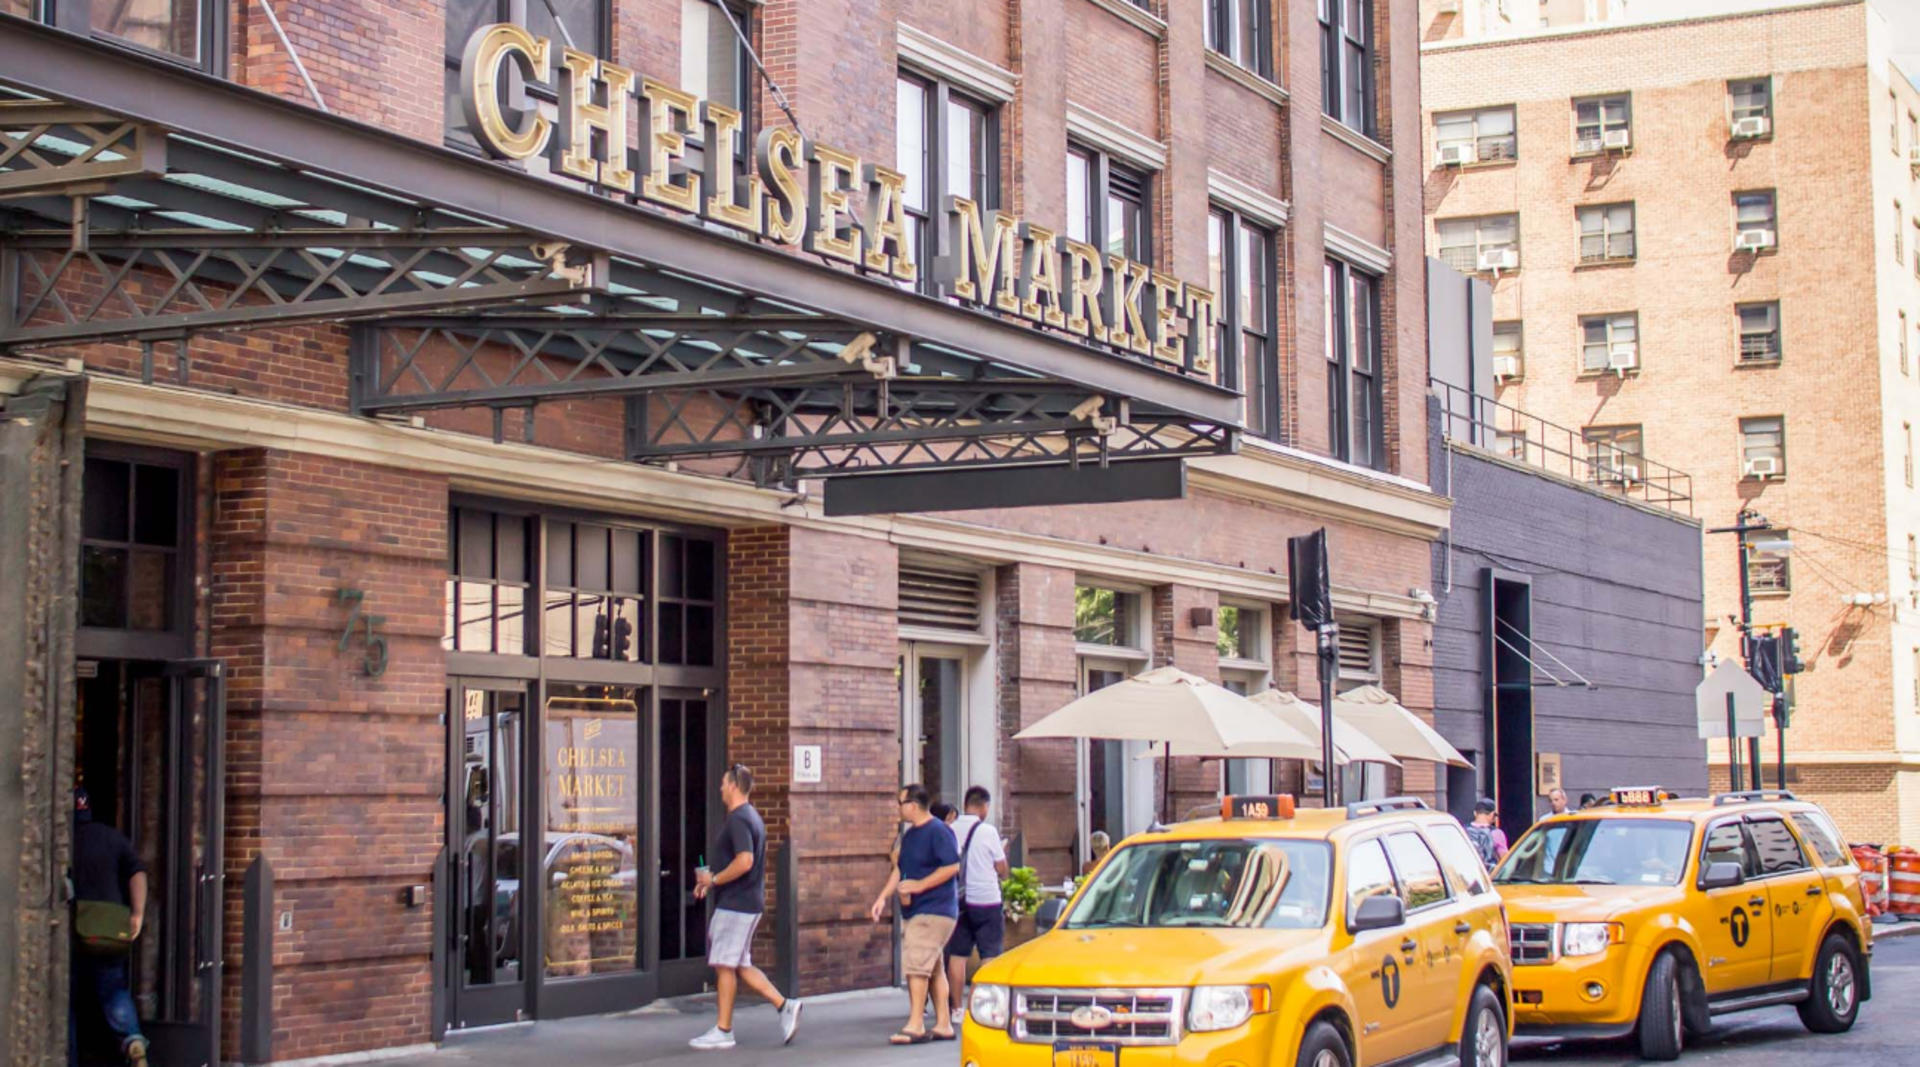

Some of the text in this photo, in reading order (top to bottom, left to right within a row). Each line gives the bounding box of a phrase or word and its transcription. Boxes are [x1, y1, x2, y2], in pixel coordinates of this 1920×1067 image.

[461, 22, 1216, 374] CHELSEA MARKET
[337, 588, 388, 677] 75
[557, 747, 625, 768] CHELSEA
[804, 750, 811, 768] B
[558, 774, 625, 797] MARKET
[1242, 802, 1269, 817] 1A59
